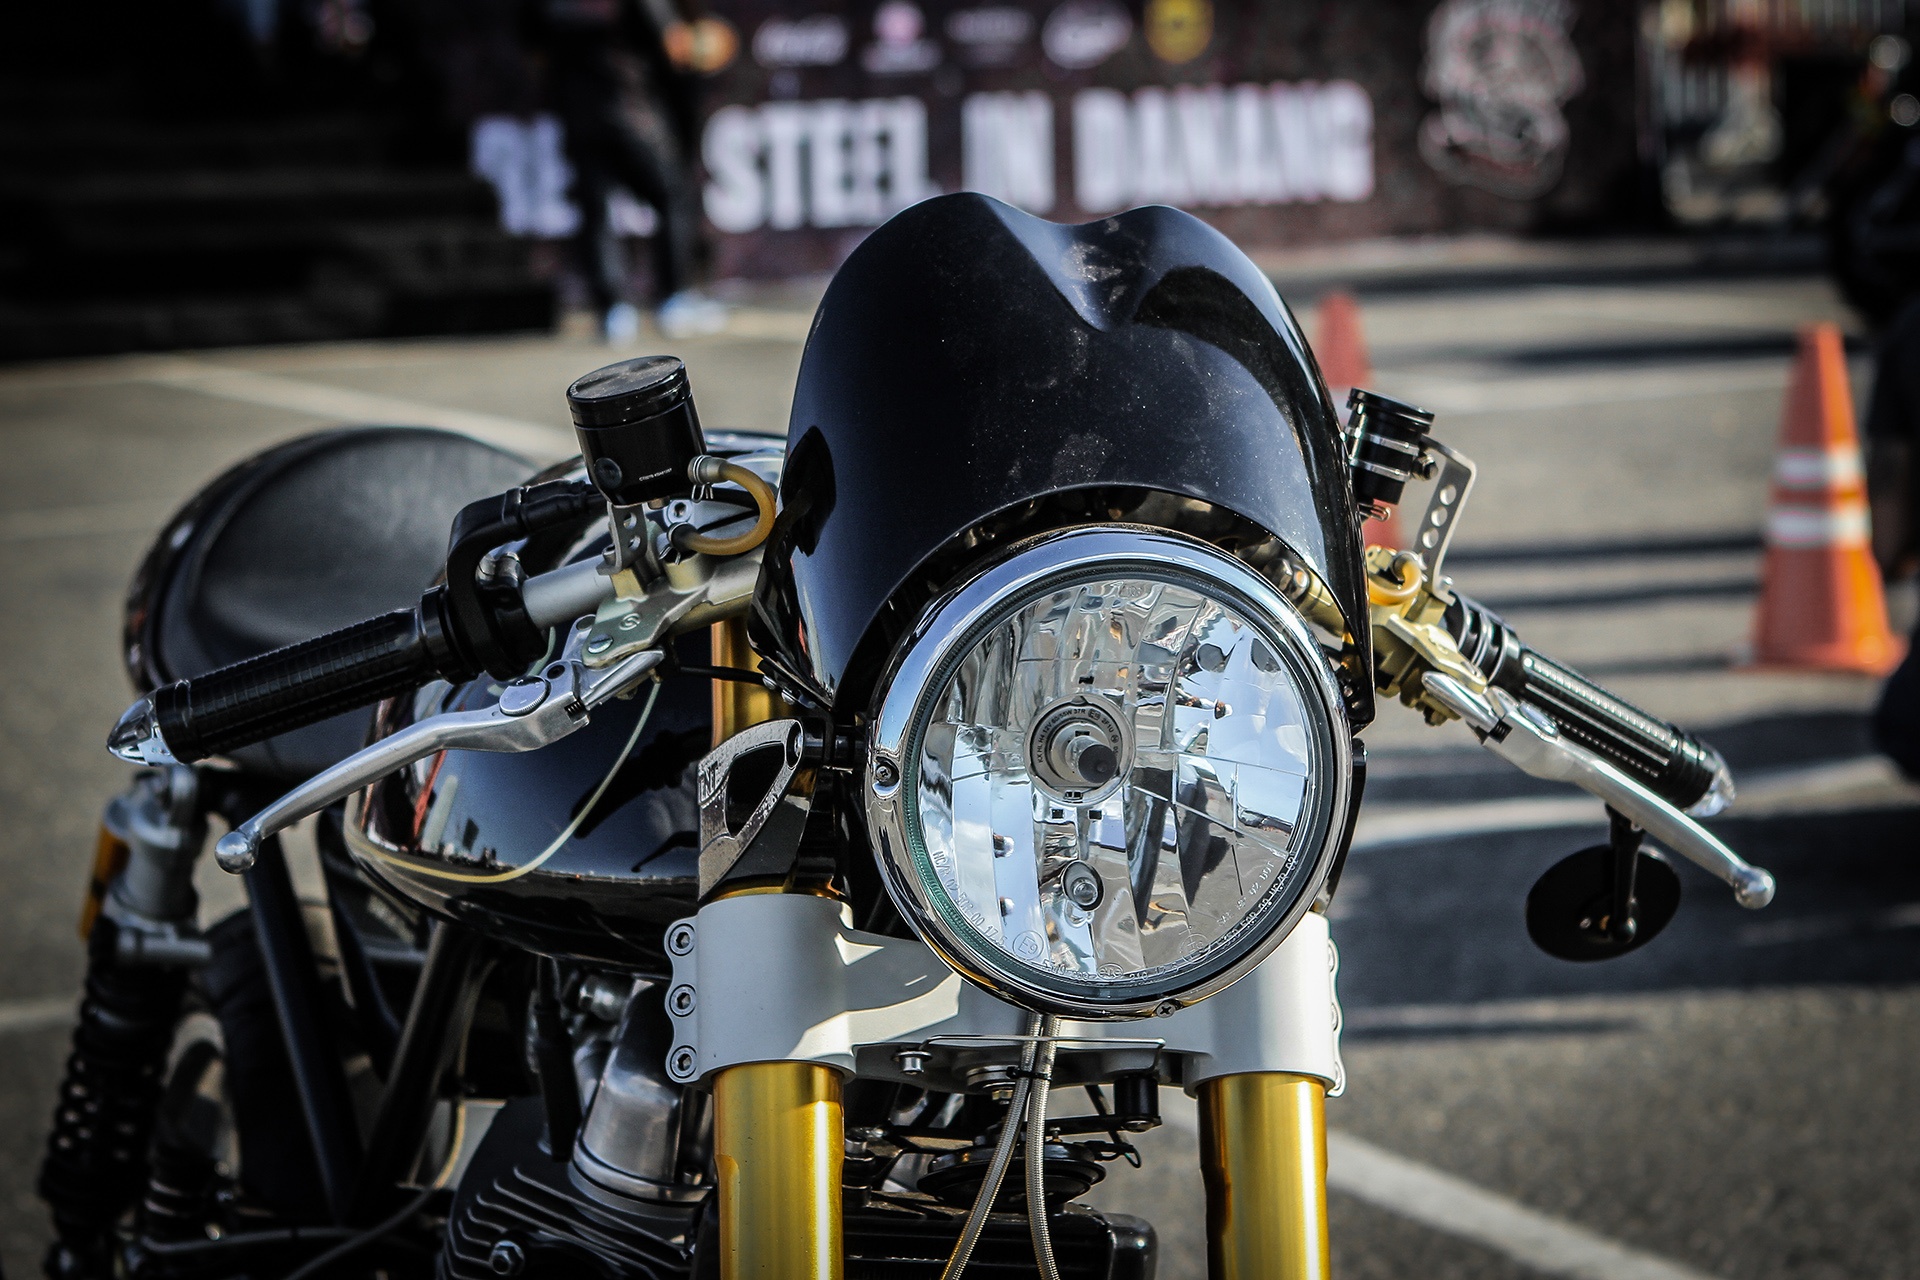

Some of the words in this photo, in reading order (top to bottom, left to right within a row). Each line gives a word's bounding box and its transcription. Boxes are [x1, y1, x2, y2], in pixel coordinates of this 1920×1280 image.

[700, 97, 938, 233] STEEL
[960, 89, 1055, 214] IN
[1073, 79, 1375, 214] DANANG
